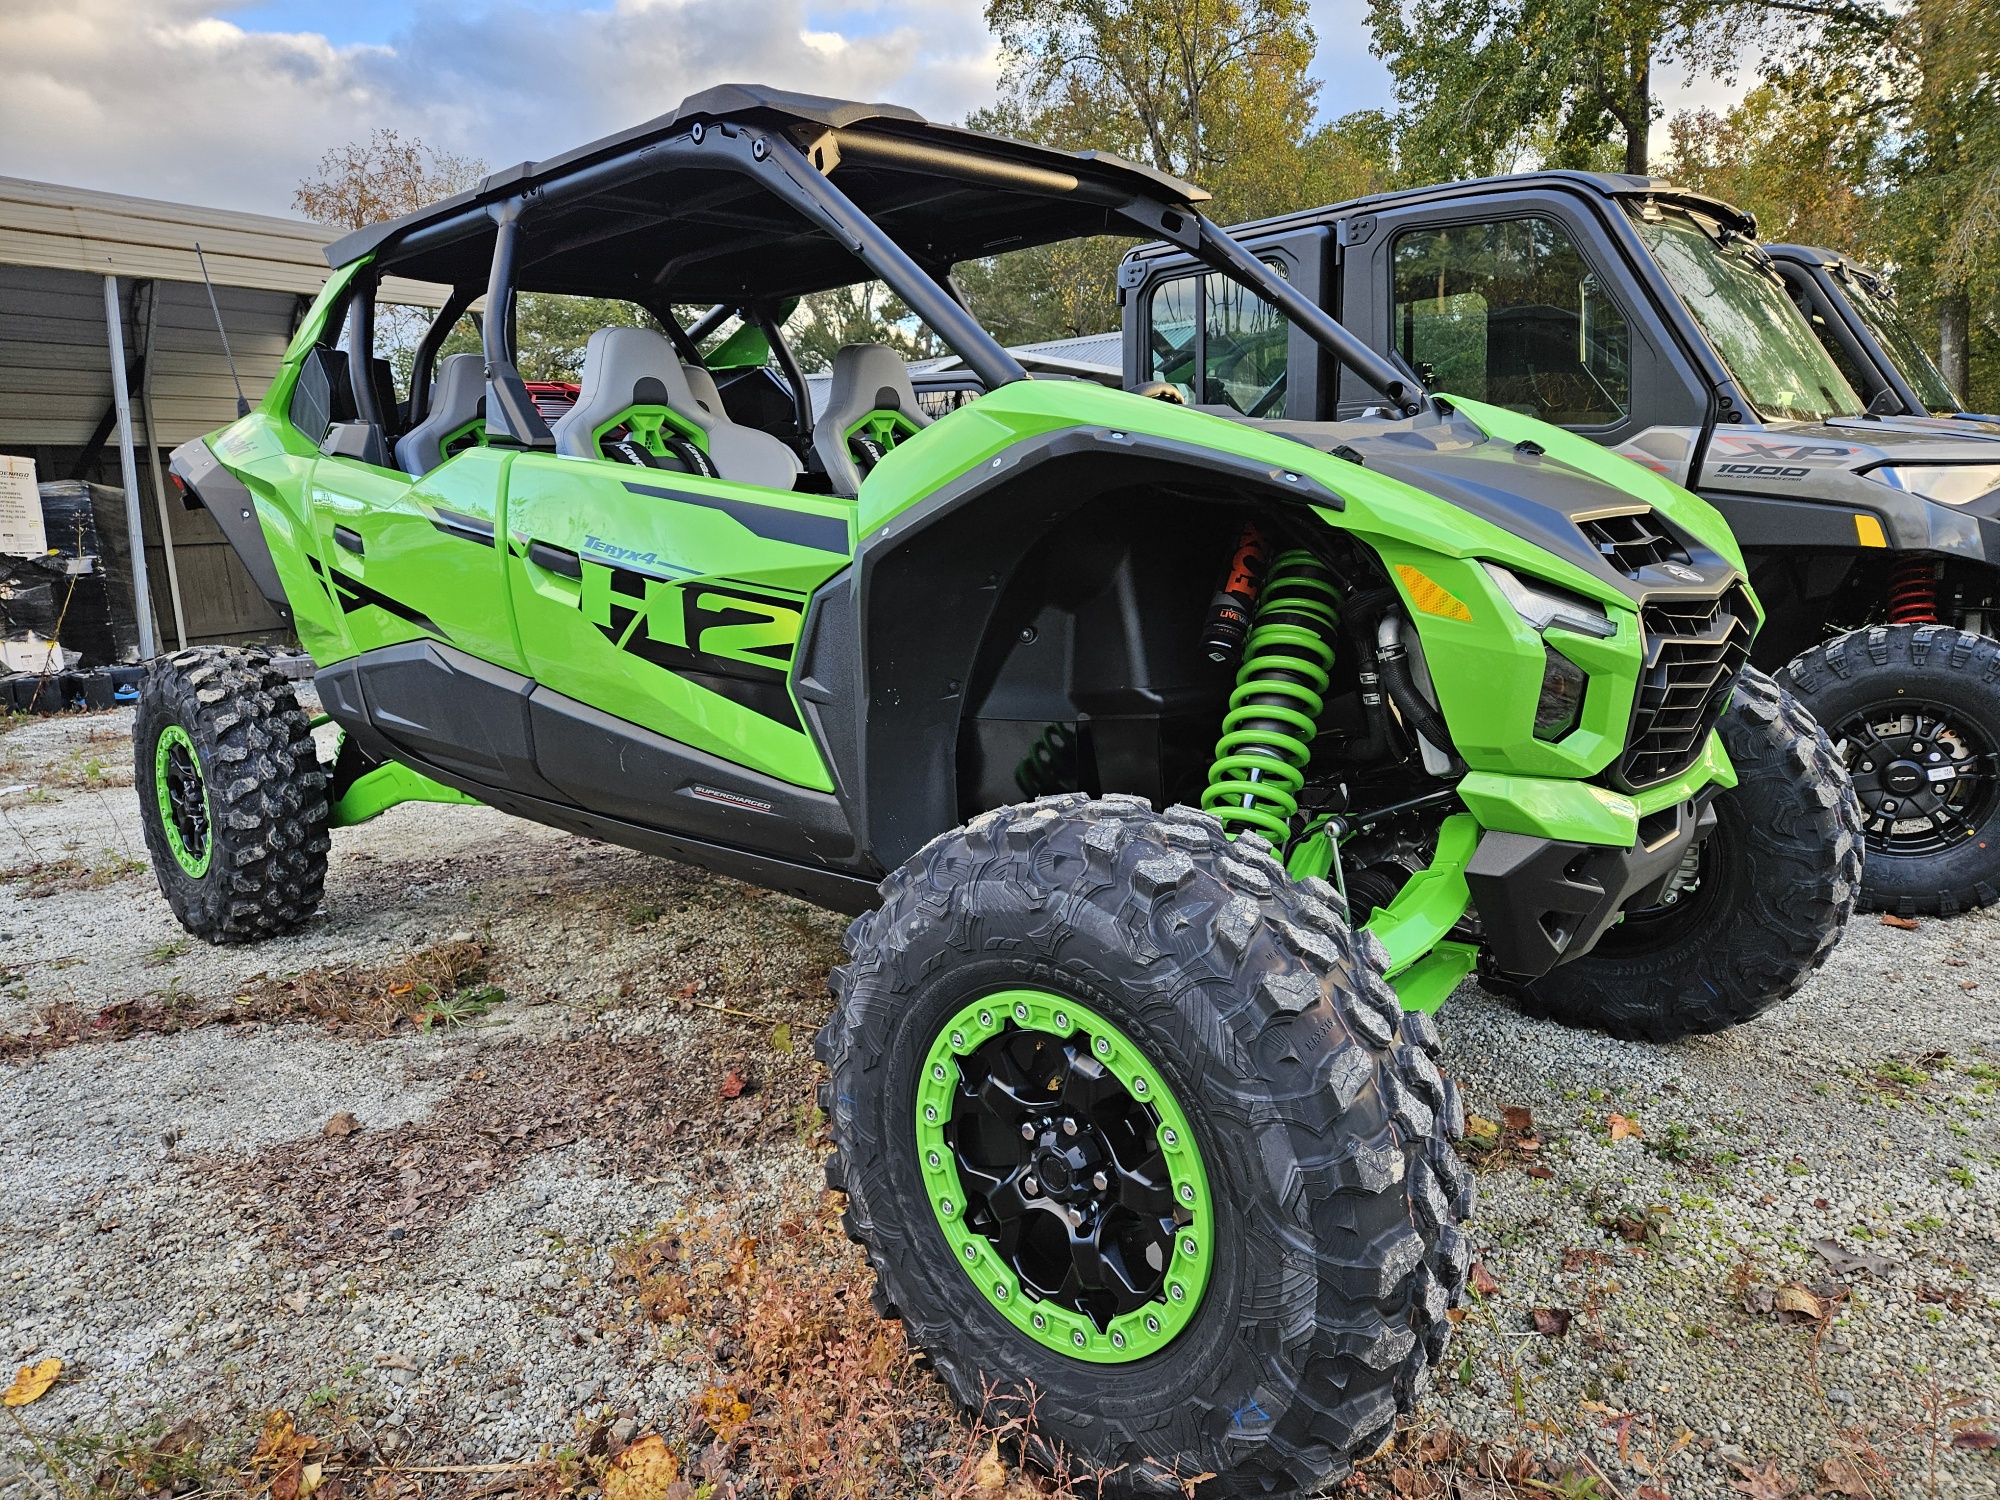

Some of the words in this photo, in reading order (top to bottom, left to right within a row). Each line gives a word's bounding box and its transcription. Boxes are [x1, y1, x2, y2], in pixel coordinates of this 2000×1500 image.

[1726, 443, 1852, 460] XP
[1717, 464, 1811, 477] 1000
[580, 560, 803, 673] H2
[1220, 610, 1239, 620] LIVE
[694, 786, 771, 809] SUPERCHARGED
